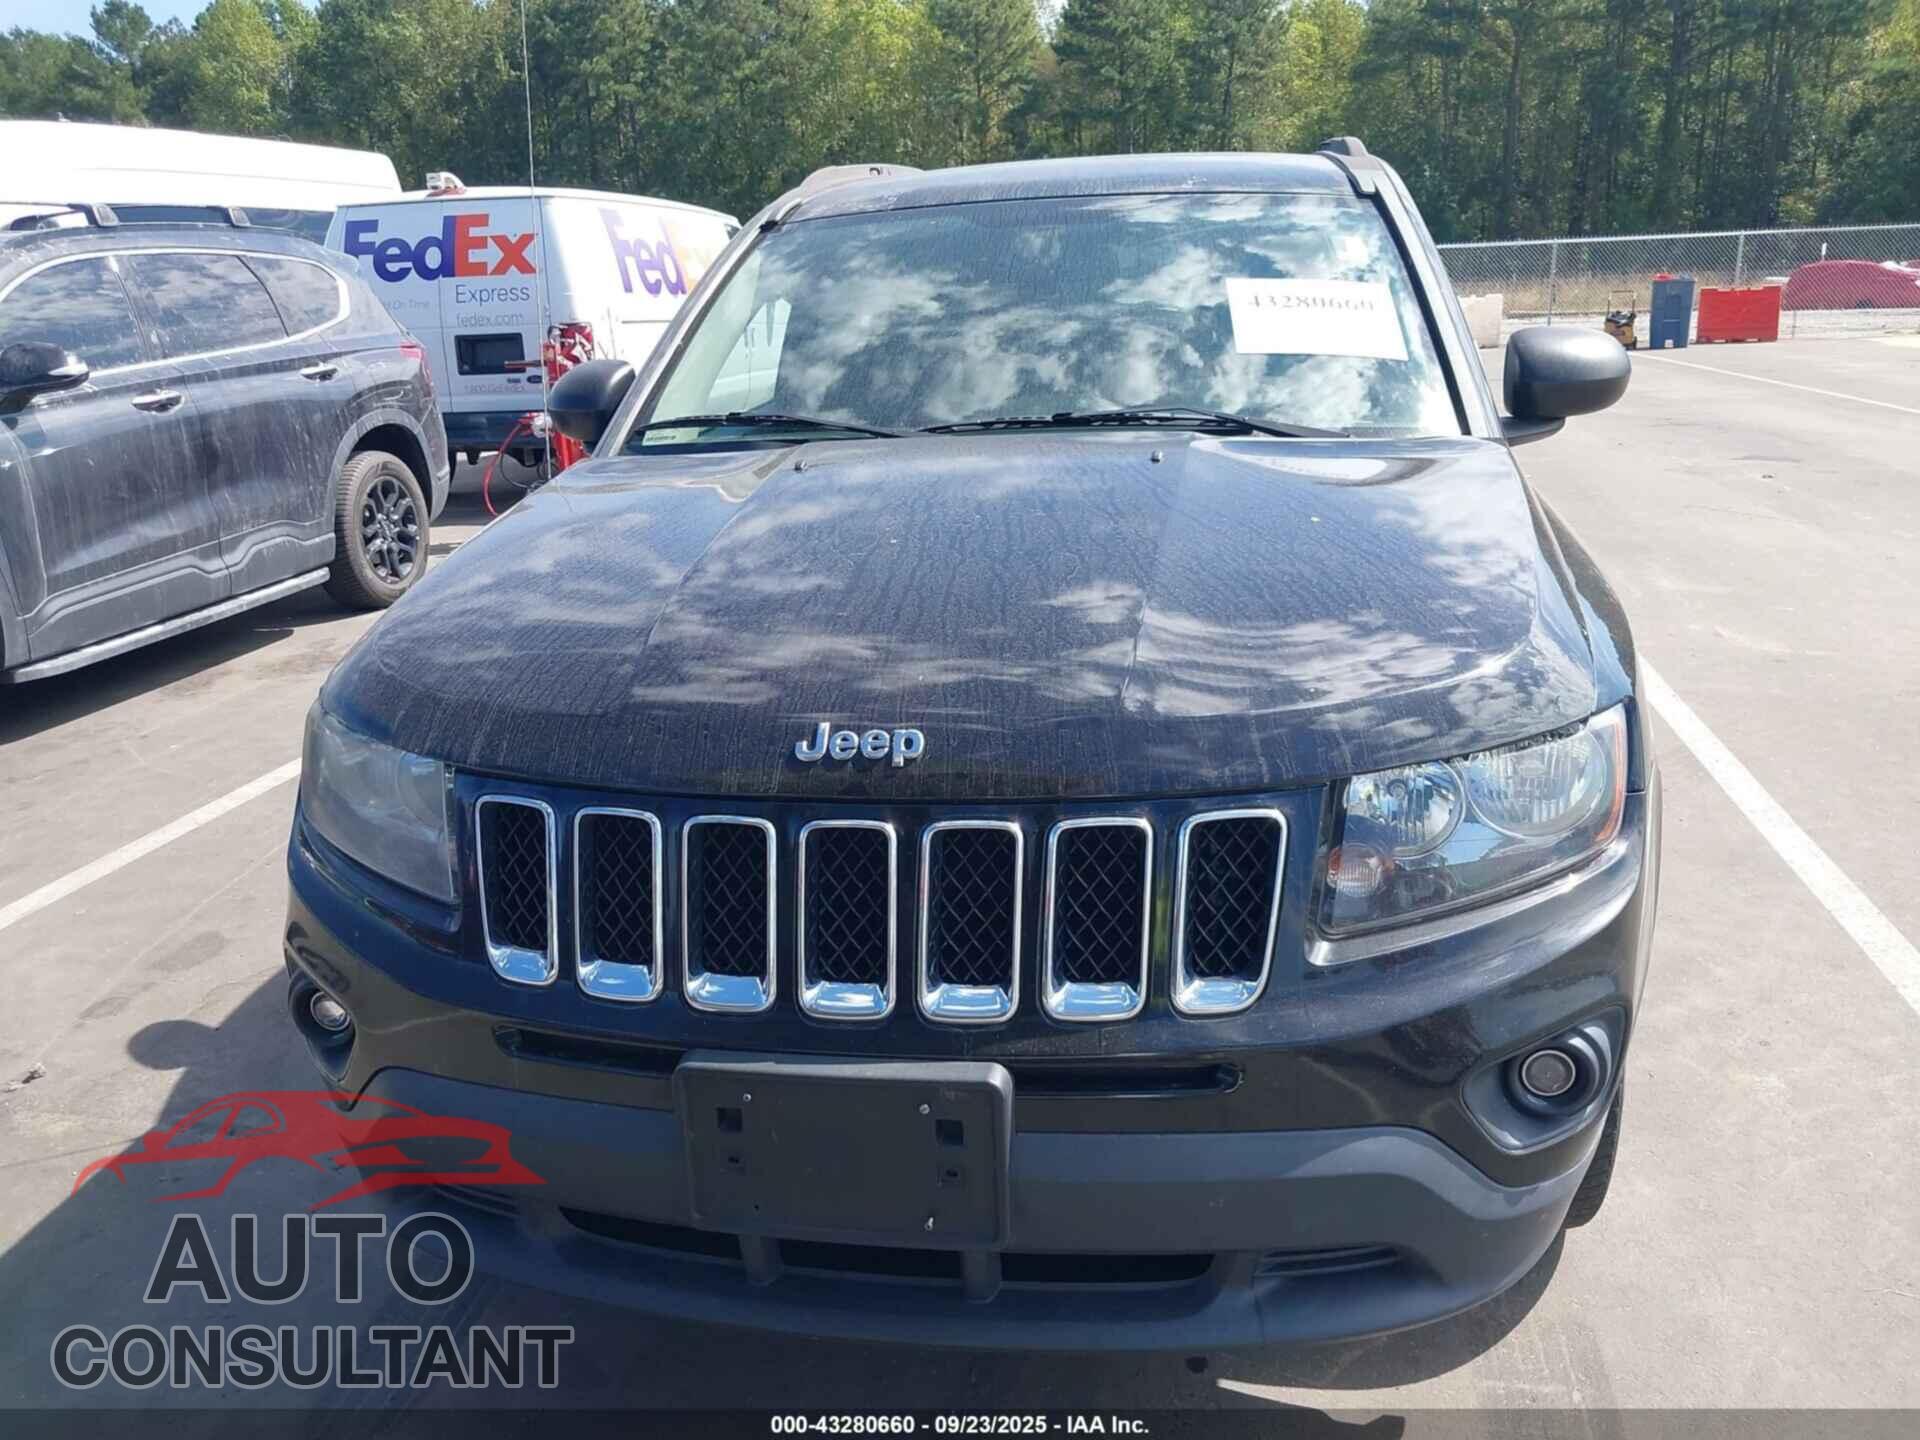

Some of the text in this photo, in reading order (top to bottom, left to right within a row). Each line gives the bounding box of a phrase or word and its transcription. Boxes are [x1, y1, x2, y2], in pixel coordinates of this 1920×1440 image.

[344, 213, 537, 283] FedEx
[455, 284, 531, 307] Express
[456, 311, 524, 328] fedex.com
[795, 721, 925, 767] Jeep
